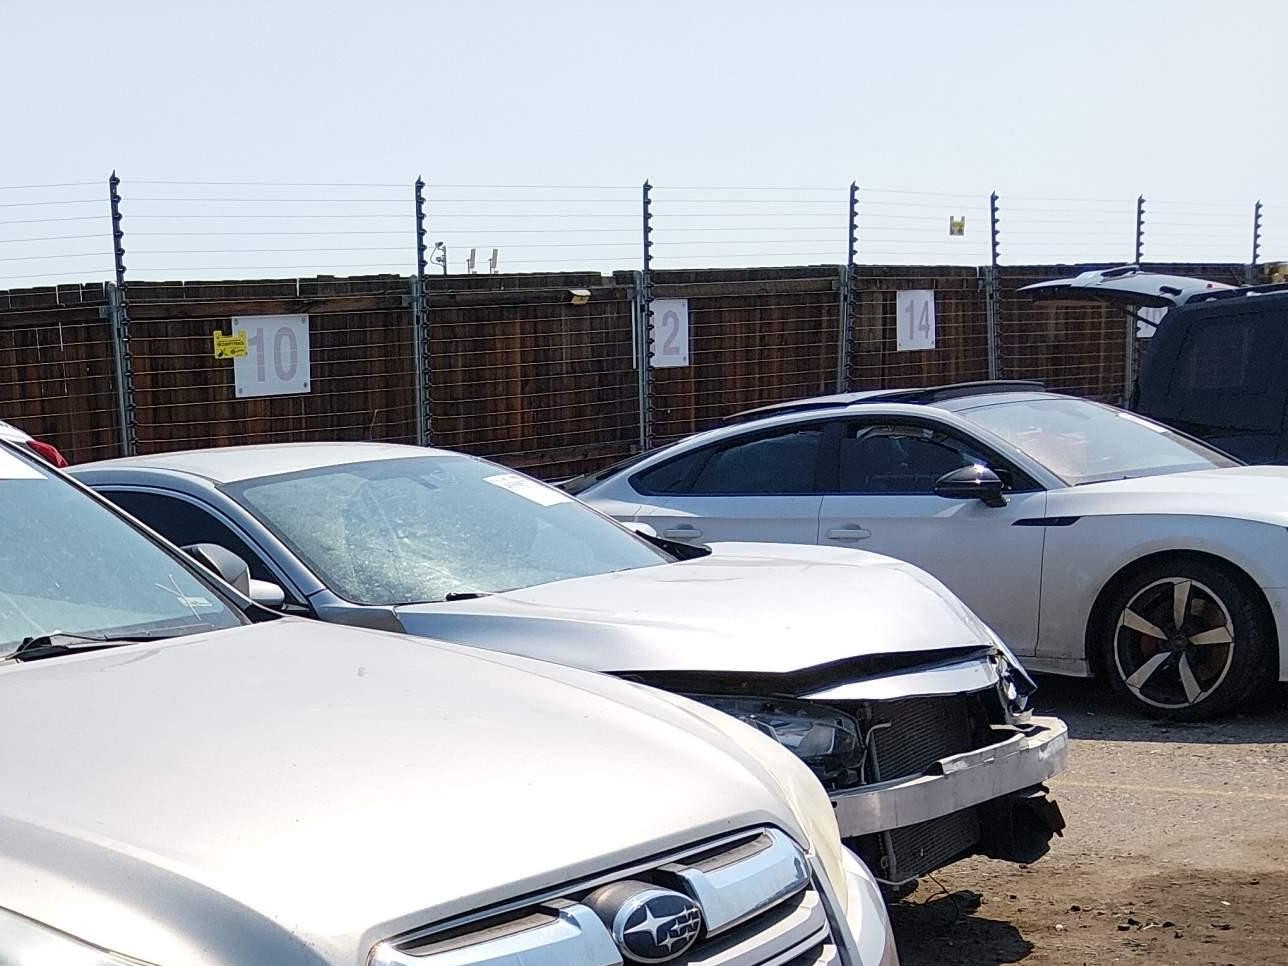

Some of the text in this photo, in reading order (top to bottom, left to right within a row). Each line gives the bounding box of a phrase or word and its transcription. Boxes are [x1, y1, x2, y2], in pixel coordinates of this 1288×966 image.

[662, 310, 681, 356] 2
[905, 299, 929, 340] 14
[248, 327, 298, 382] 10
